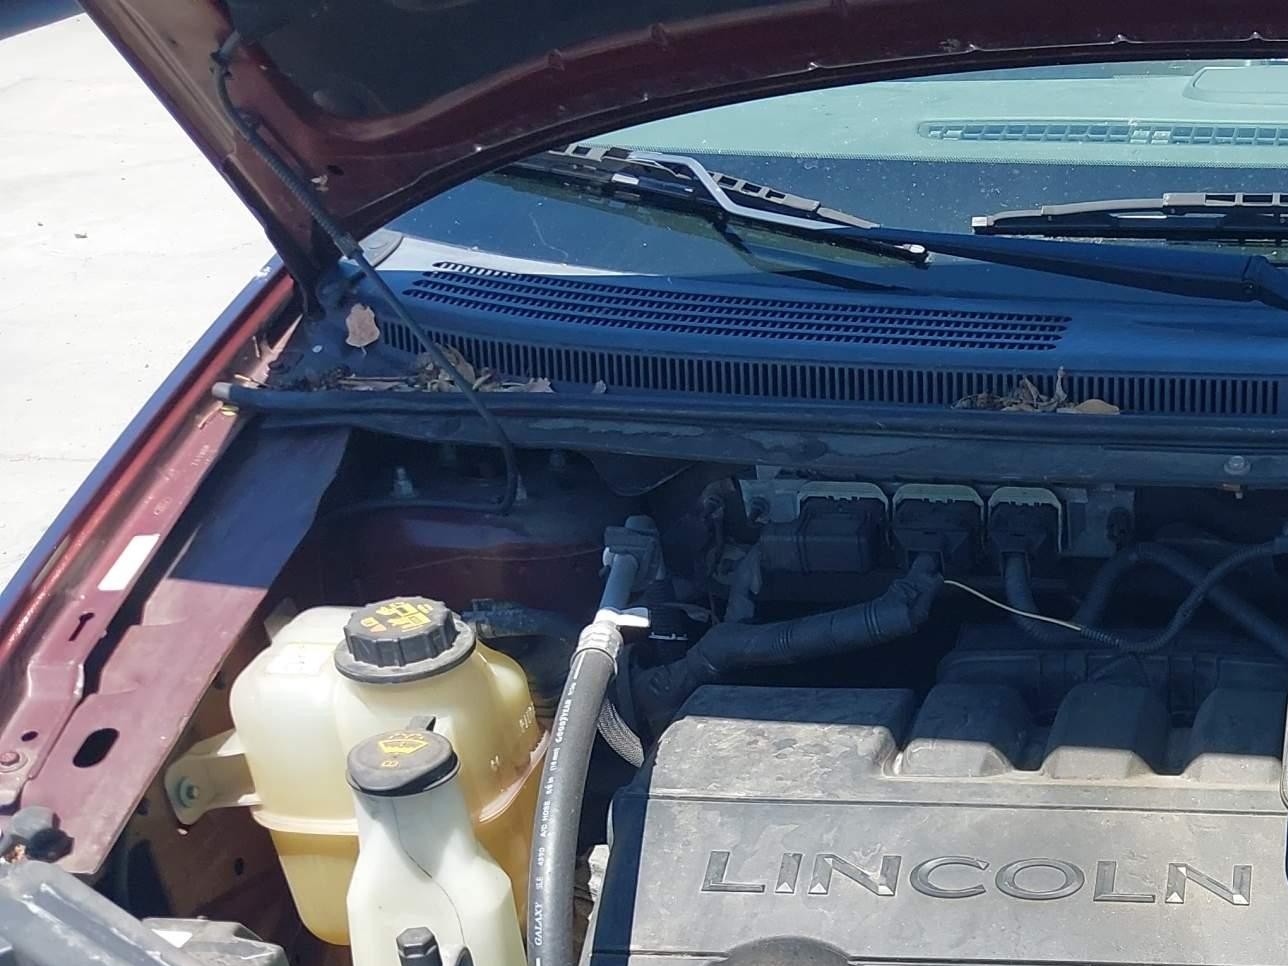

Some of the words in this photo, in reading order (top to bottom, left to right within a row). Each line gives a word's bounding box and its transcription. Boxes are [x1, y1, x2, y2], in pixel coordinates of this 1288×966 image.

[534, 902, 544, 946] GALAXY
[542, 801, 551, 821] HOSE
[555, 699, 572, 743] GOODYEAR
[701, 851, 1251, 906] LINCOLN
